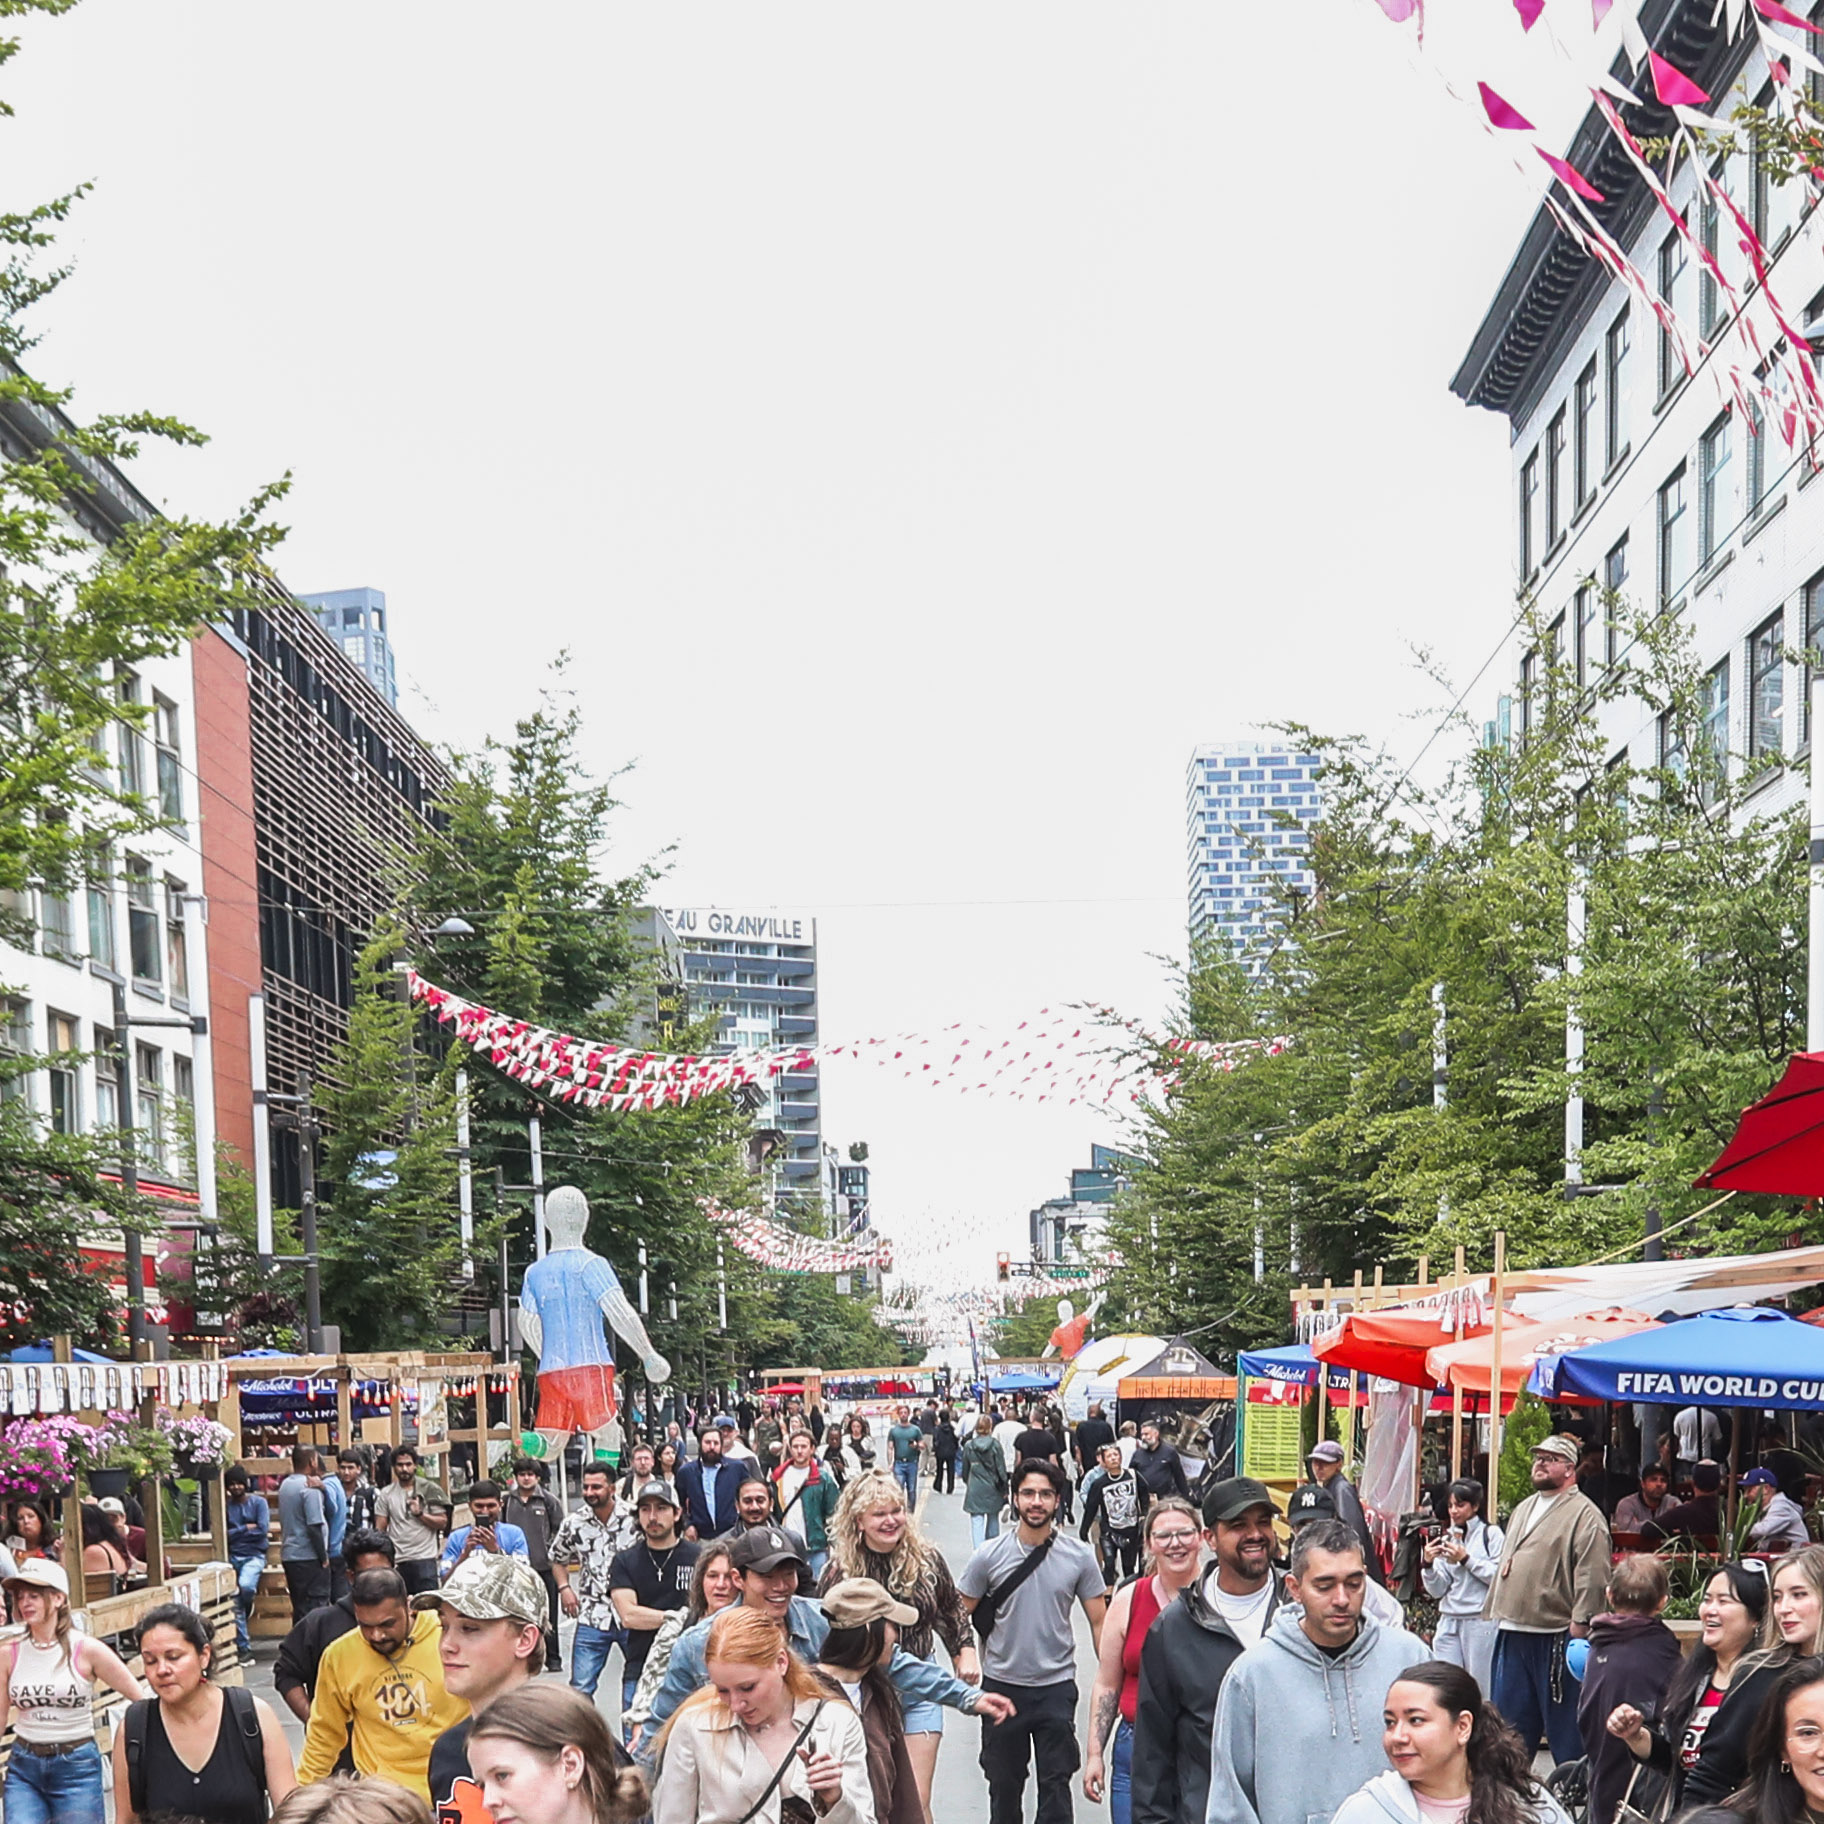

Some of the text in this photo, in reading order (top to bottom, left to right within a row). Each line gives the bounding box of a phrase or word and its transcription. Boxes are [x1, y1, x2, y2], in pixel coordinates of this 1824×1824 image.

[708, 912, 802, 940] GRANVILLE
[1262, 1362, 1307, 1382] Michelob
[1616, 1372, 1677, 1395] FIFA
[1679, 1375, 1778, 1399] WORLD
[10, 1683, 79, 1699] SAVE A
